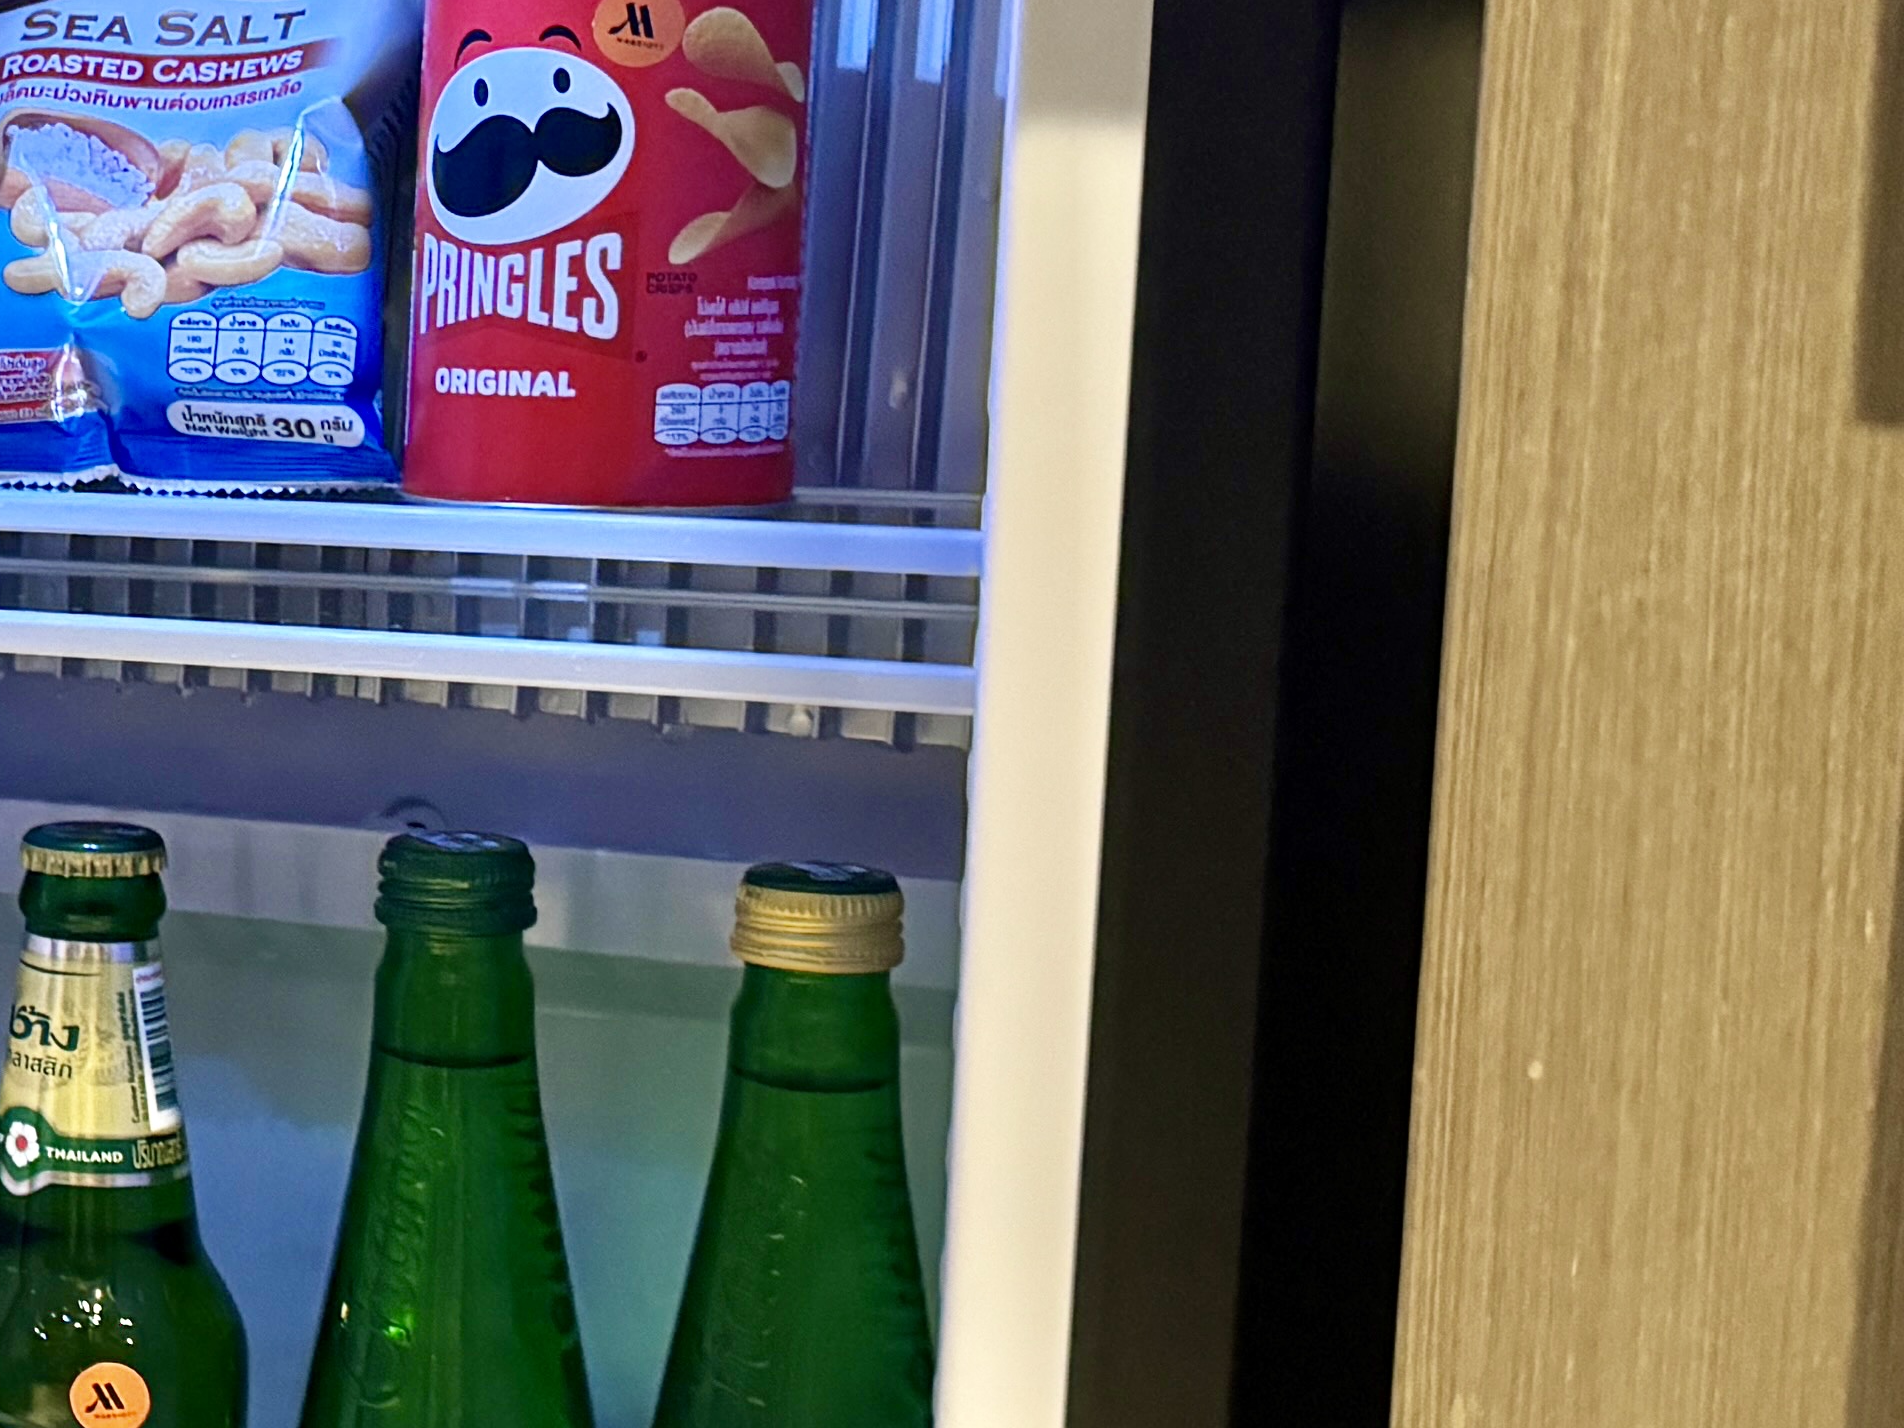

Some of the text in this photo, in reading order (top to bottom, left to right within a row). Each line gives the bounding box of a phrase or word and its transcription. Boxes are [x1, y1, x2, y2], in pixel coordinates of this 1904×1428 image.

[20, 9, 306, 47] SEA SALT
[1, 50, 303, 83] ROASTED CASHEWS
[420, 232, 622, 340] PRINGLES
[435, 367, 576, 397] ORIGINAL
[272, 417, 316, 439] 30
[7, 1049, 73, 1079] ลาสสิก
[45, 1146, 123, 1163] THAILAND
